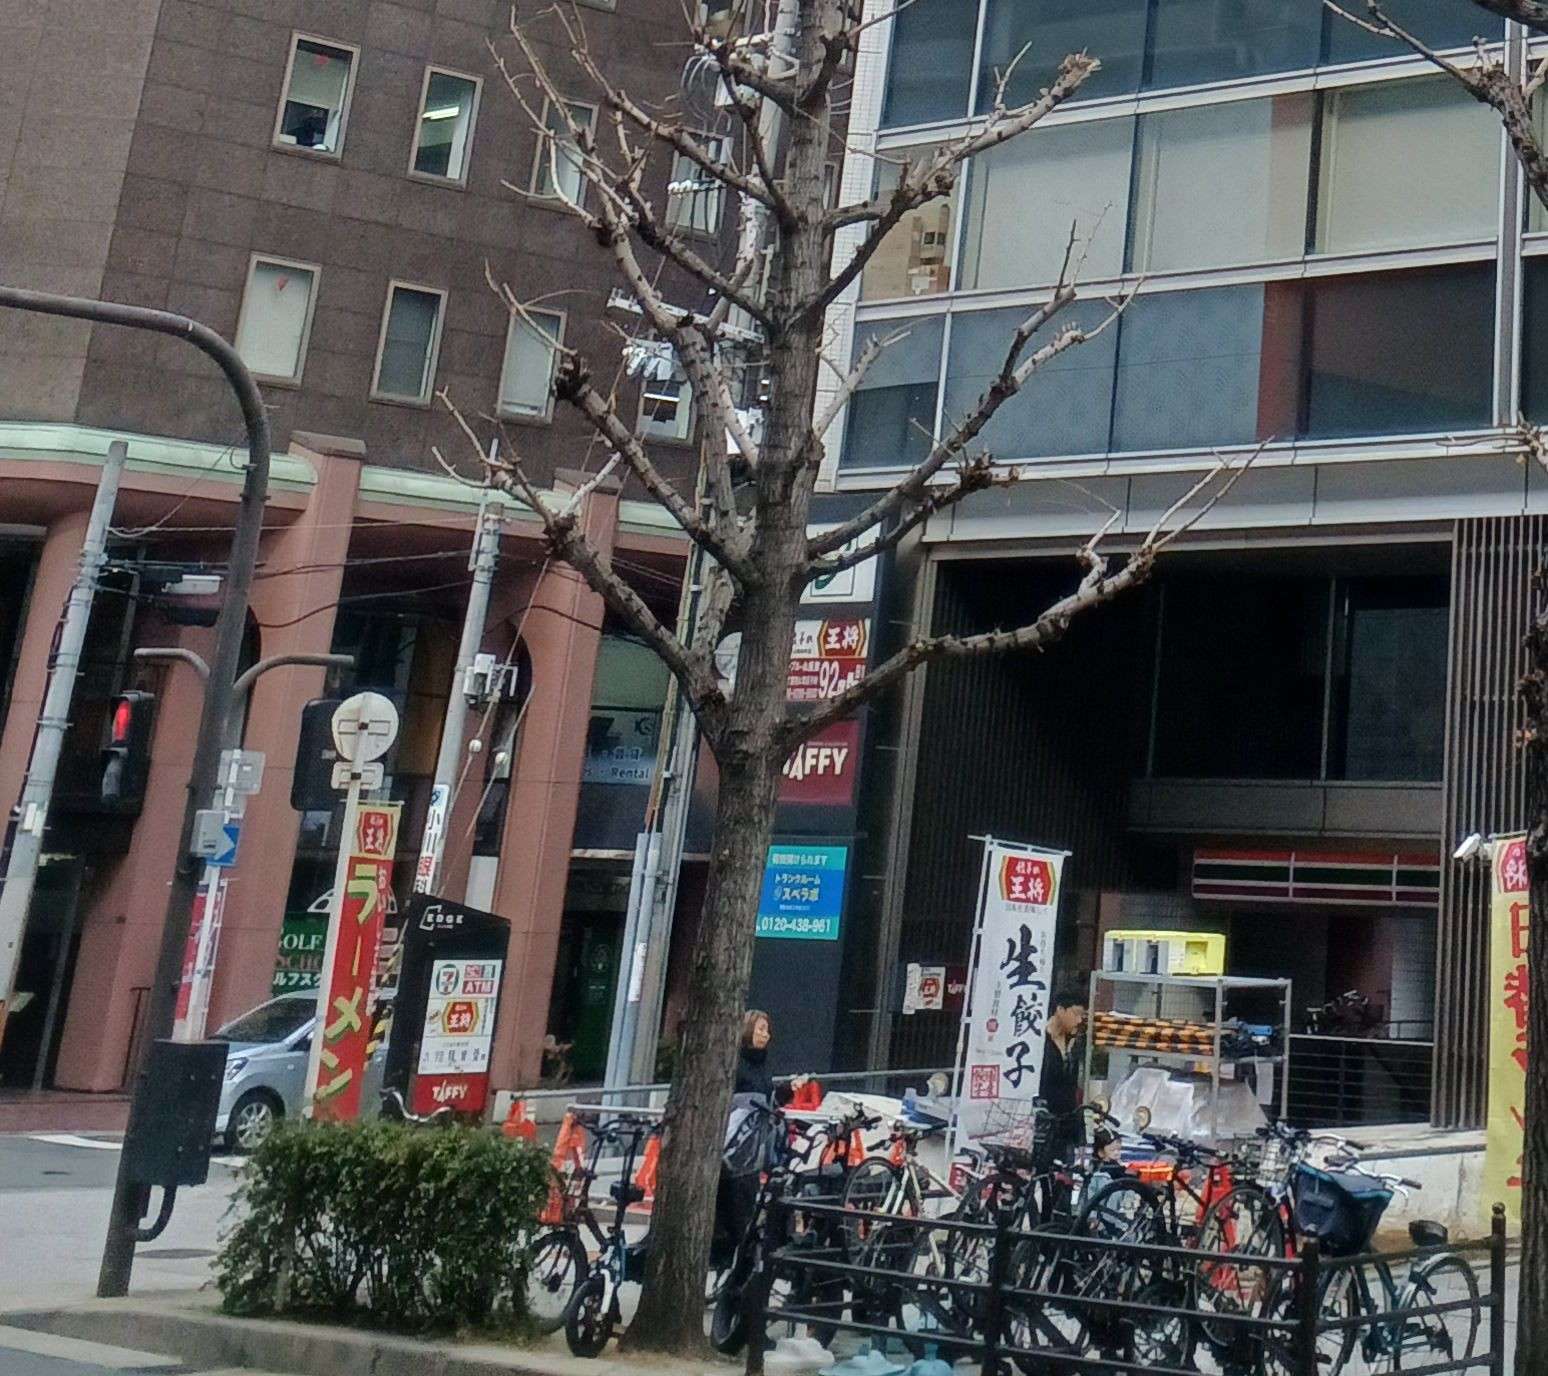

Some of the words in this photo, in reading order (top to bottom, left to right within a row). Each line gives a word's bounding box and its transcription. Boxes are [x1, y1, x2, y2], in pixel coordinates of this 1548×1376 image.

[824, 625, 859, 650] 王将
[611, 767, 649, 780] Rental
[1009, 875, 1045, 903] 王将
[426, 912, 464, 925] EDGE
[315, 863, 378, 1099] ラーメン
[465, 980, 492, 994] ATM
[1000, 922, 1047, 1089] 生餃子
[432, 1079, 468, 1103] TAFFY
